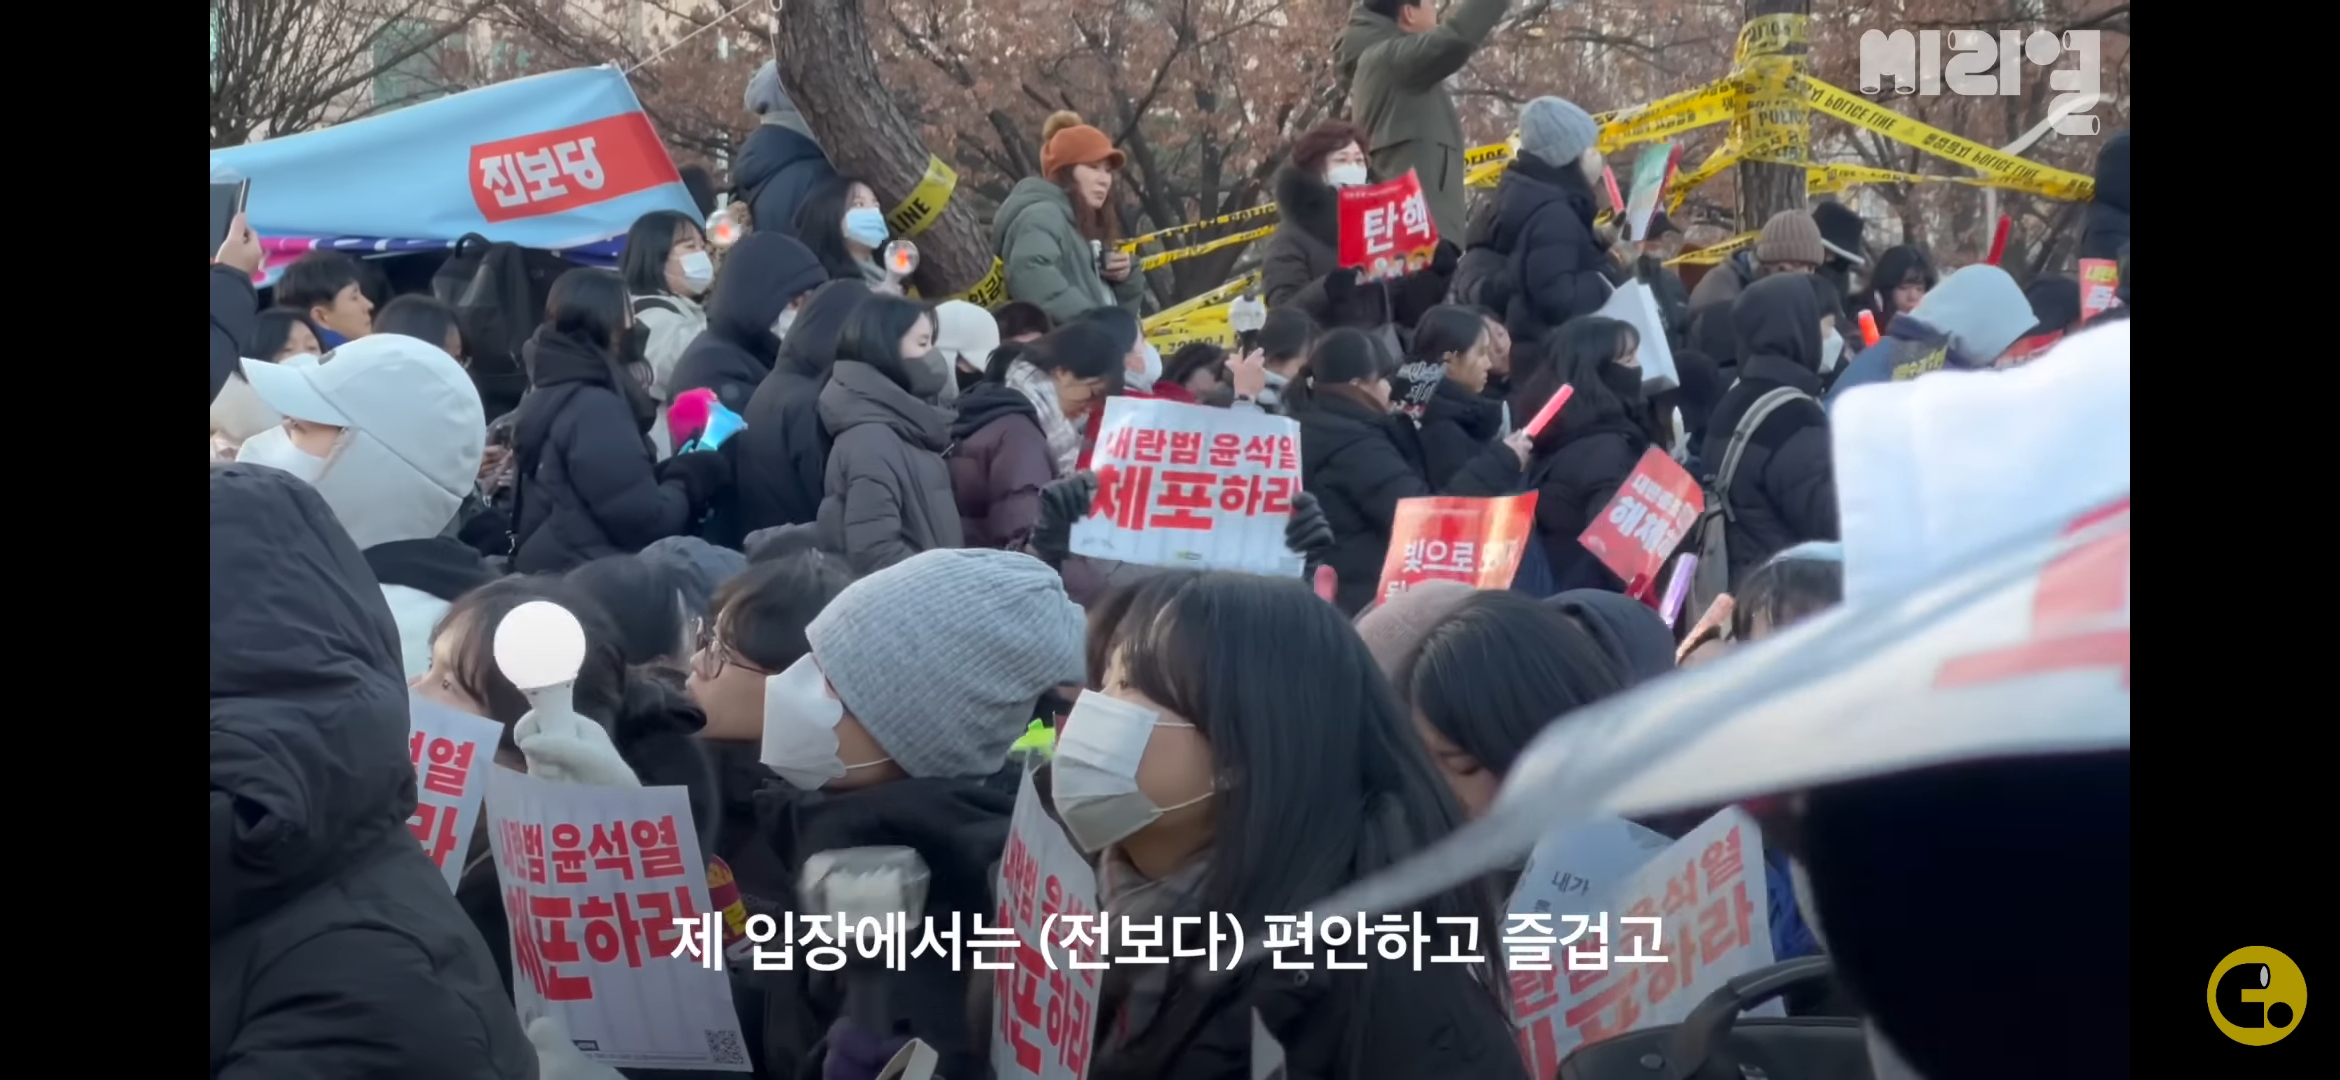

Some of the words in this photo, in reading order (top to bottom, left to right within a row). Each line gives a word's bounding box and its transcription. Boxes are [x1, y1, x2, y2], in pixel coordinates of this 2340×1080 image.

[479, 135, 605, 208] 진보당
[889, 197, 931, 234] LINE
[1363, 189, 1430, 255] 탄핵
[1087, 462, 1302, 532] 체포하라
[1402, 538, 1476, 573] 빛으로
[551, 814, 686, 884] 윤석열
[1551, 870, 1590, 896] 내가
